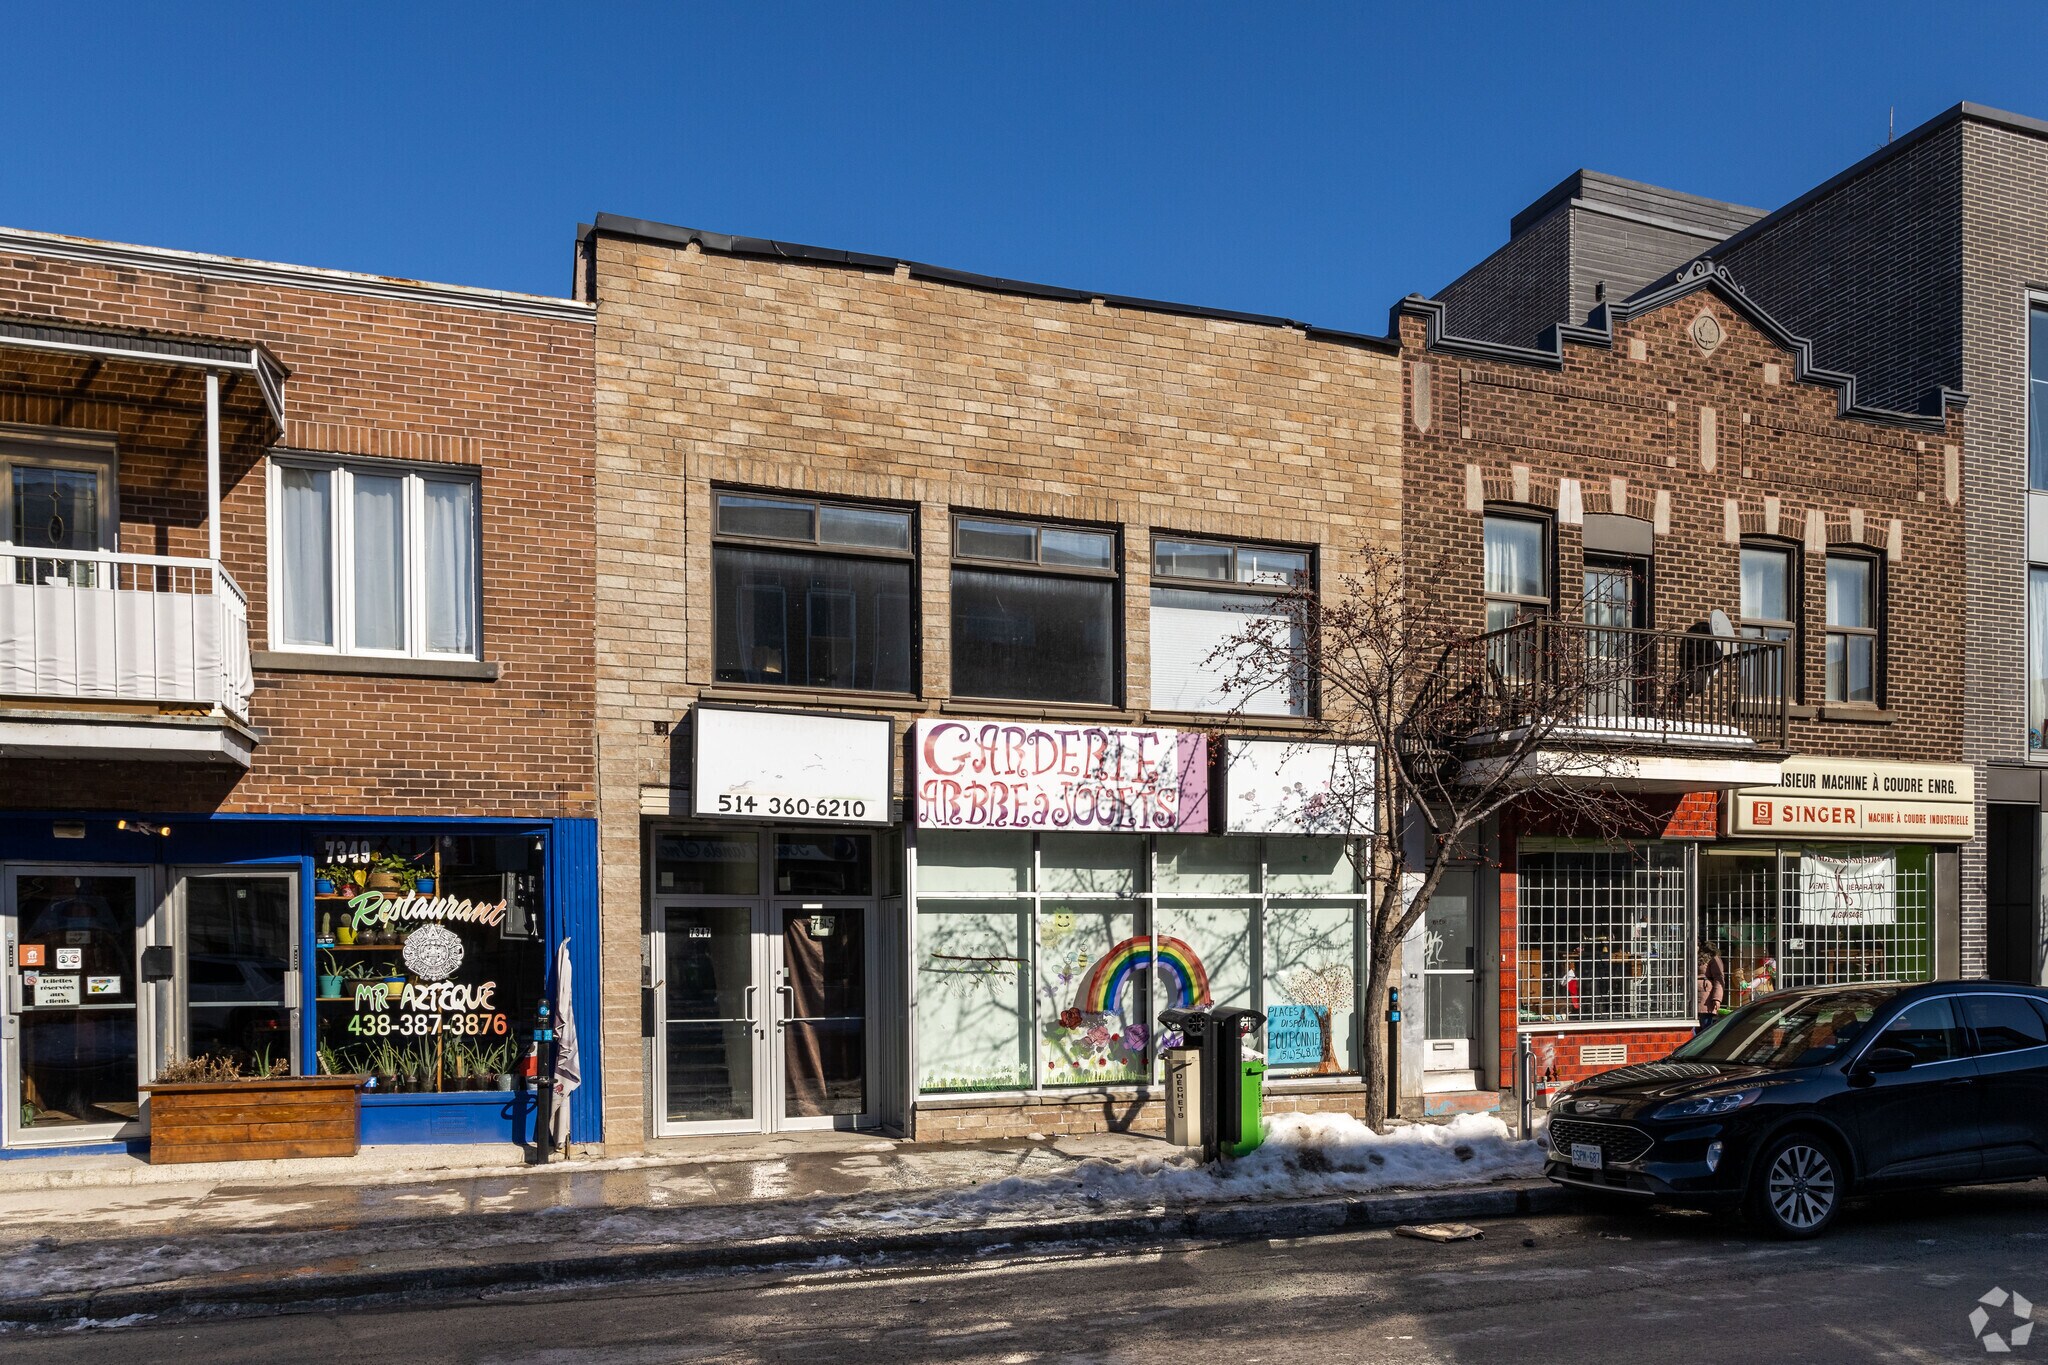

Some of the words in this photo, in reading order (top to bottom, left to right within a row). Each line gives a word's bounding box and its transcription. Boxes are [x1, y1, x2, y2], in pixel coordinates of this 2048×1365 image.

[923, 722, 1160, 783] GARDERIE
[1771, 772, 1817, 789] NSIEUR
[1821, 774, 1868, 791] MACHINE
[1872, 772, 1879, 791] À
[1883, 777, 1923, 793] COUDRE
[1928, 778, 1957, 795] ENRG.
[718, 794, 758, 813] 514
[768, 797, 866, 818] 360-6210
[919, 779, 1030, 828] ARBRE
[1050, 781, 1176, 830] JOUETS
[1759, 805, 1767, 816] S
[1782, 805, 1856, 824] SINGER
[1868, 813, 1894, 824] MACHINE
[1896, 811, 1901, 824] À
[1903, 814, 1926, 825] COUDRE
[1929, 815, 1969, 826] INDUSTRIELLE
[325, 841, 371, 864] 7349
[1808, 882, 1830, 890] VENTE
[348, 889, 507, 931] Restaurant
[690, 928, 711, 937] 7347
[354, 982, 390, 1012] MR
[1267, 1007, 1299, 1018] PLACES
[347, 1013, 507, 1036] 438-387-3876
